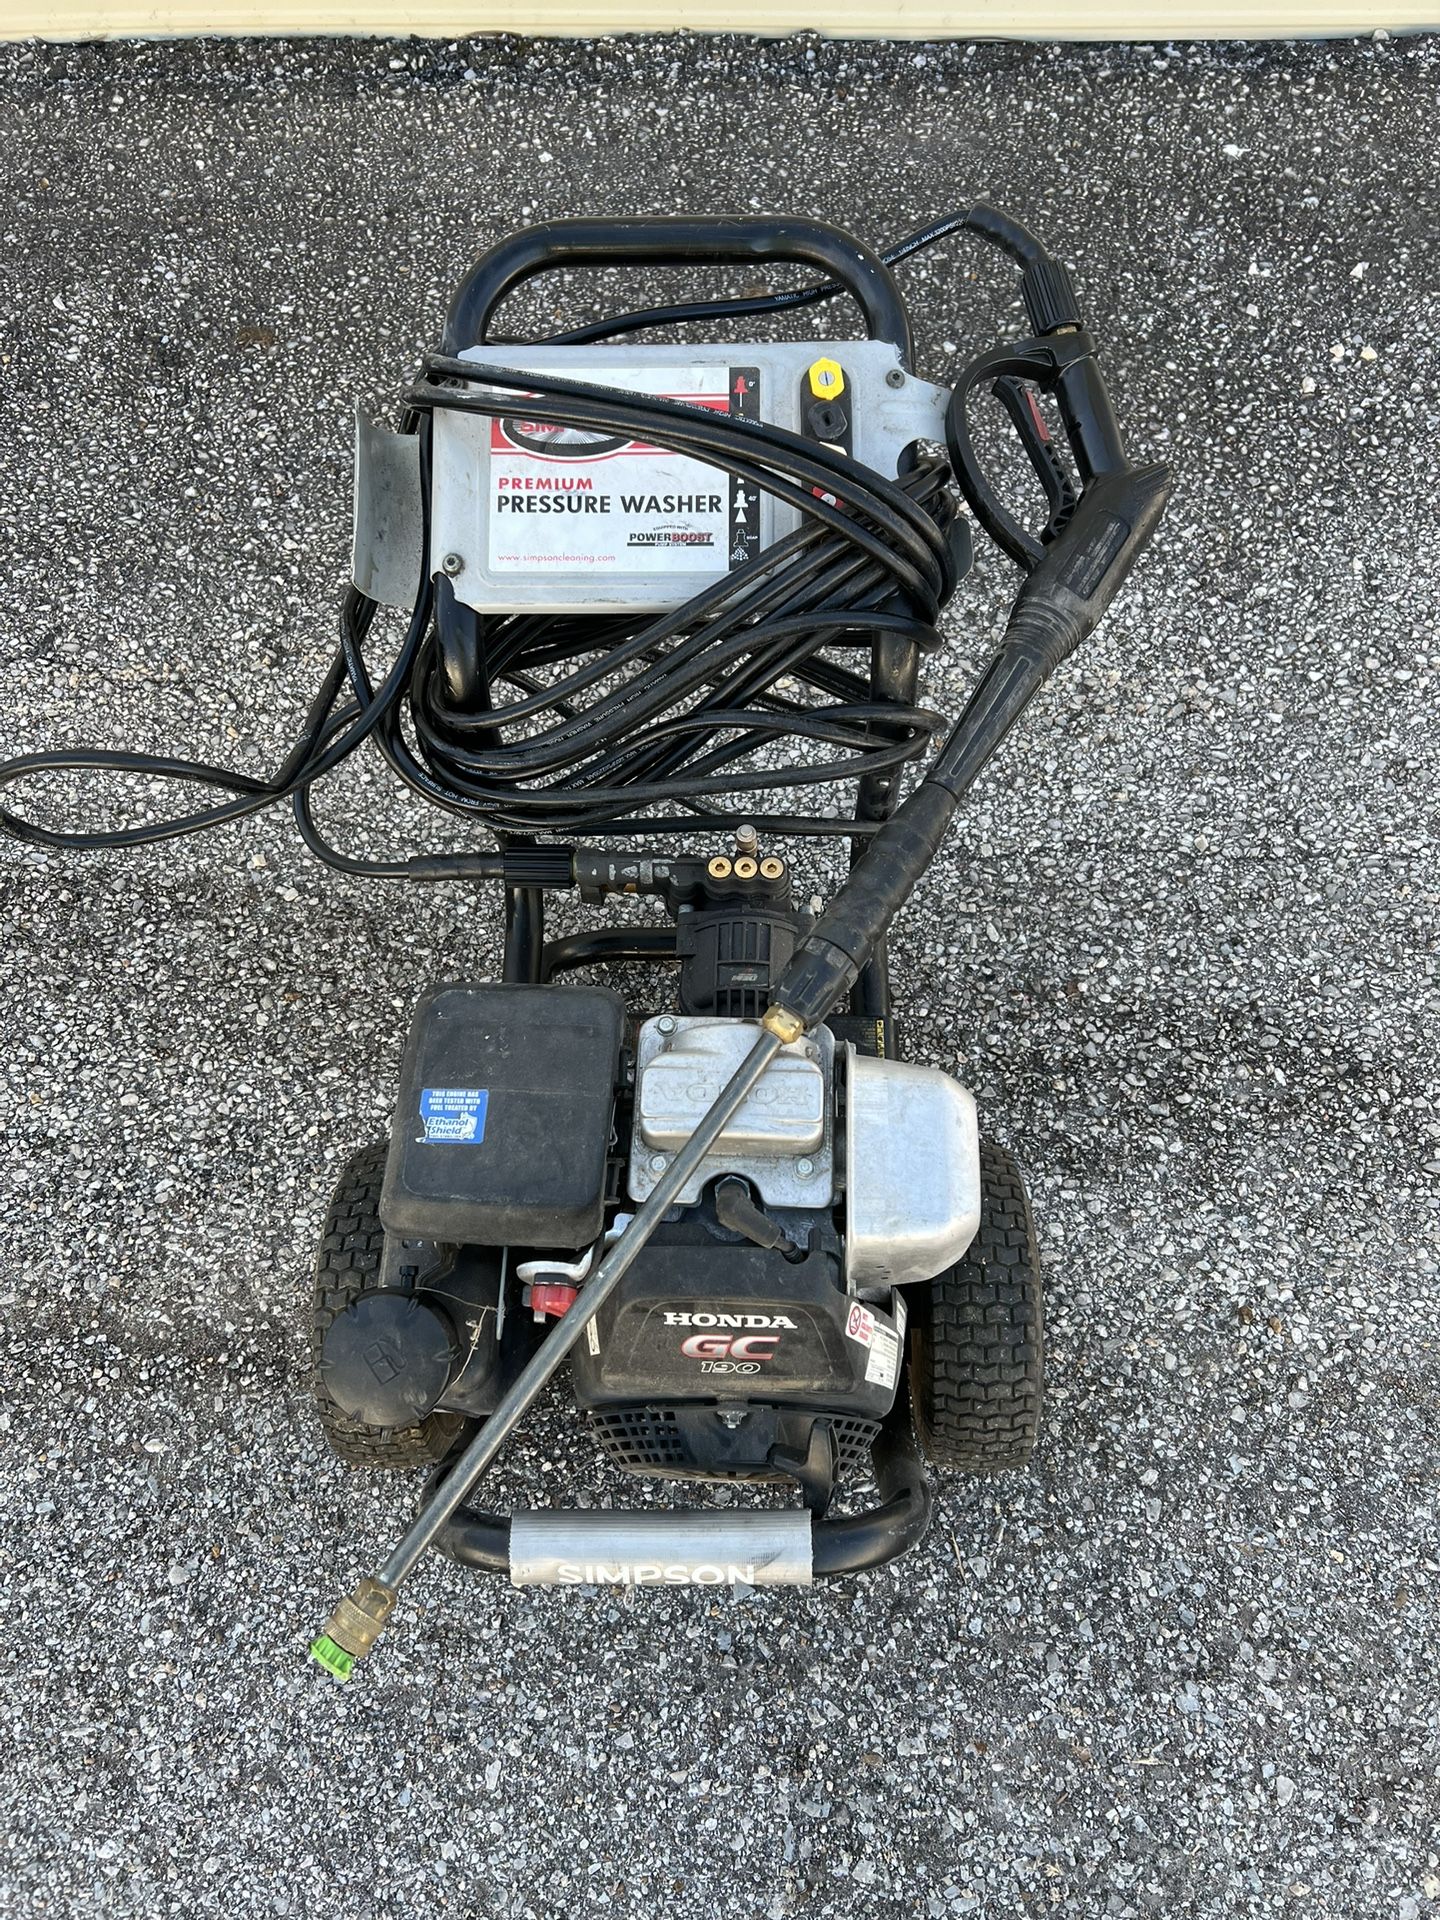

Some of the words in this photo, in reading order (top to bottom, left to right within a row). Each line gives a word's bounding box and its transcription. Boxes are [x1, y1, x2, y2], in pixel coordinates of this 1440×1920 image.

[498, 477, 593, 491] PREMIUM
[496, 494, 611, 514] PRESSURE
[620, 493, 723, 513] WASHER
[497, 552, 616, 563] www.simpsoncleaning.com
[444, 790, 458, 799] HOT
[446, 1090, 467, 1098] ENGINE
[465, 1097, 481, 1105] WITH
[428, 1117, 469, 1126] Ethanol
[430, 1126, 462, 1135] Shield
[663, 1312, 798, 1329] HONDA
[681, 1334, 781, 1360] GC
[700, 1361, 761, 1374] 190
[557, 1564, 756, 1584] SIMPSON
